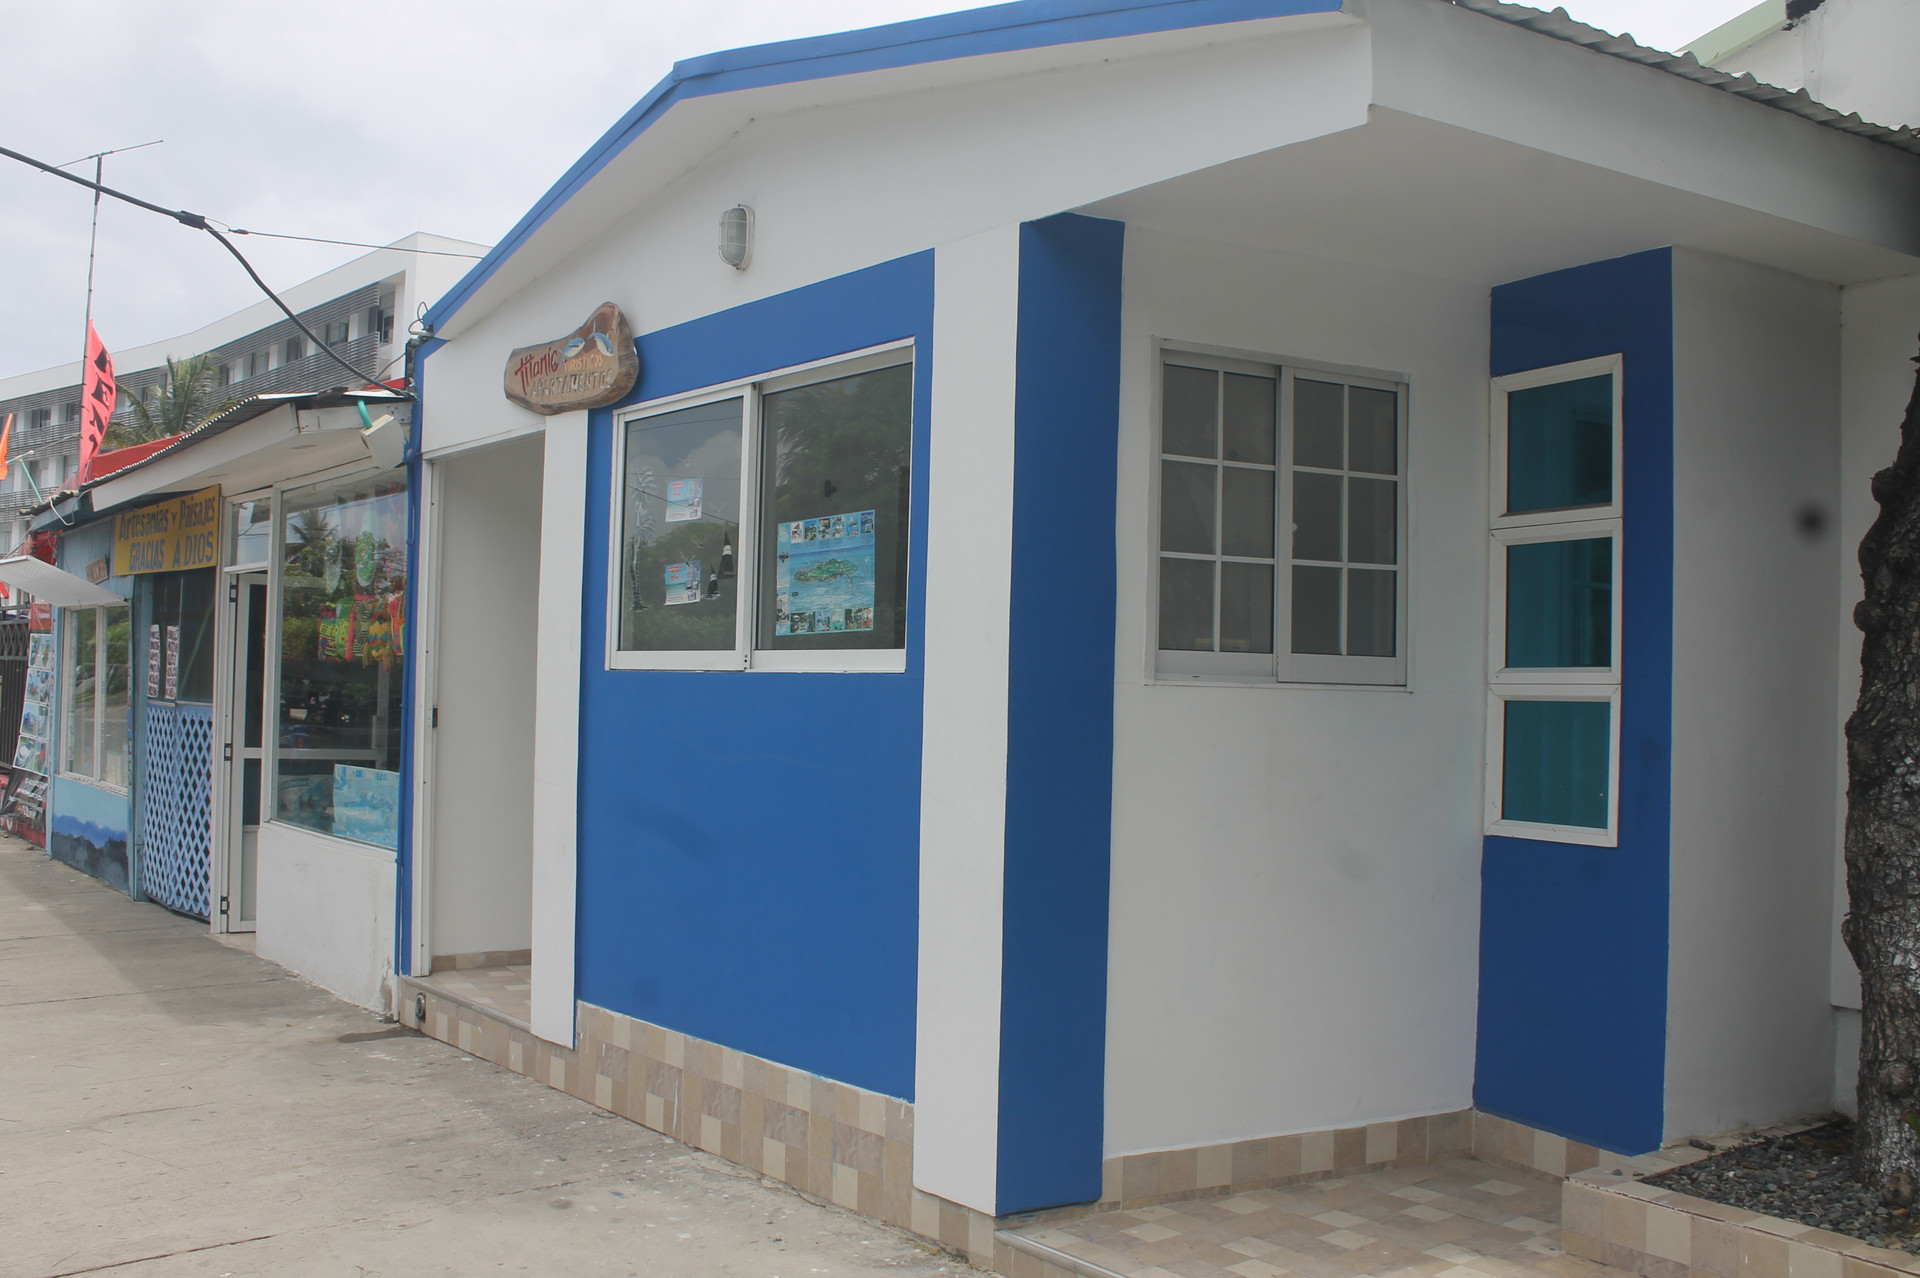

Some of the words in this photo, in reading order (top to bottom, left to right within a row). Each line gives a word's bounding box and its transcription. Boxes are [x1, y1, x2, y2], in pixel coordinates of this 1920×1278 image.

[129, 538, 165, 572] GRACIAS
[172, 538, 181, 568] A
[184, 530, 214, 566] DIOS
